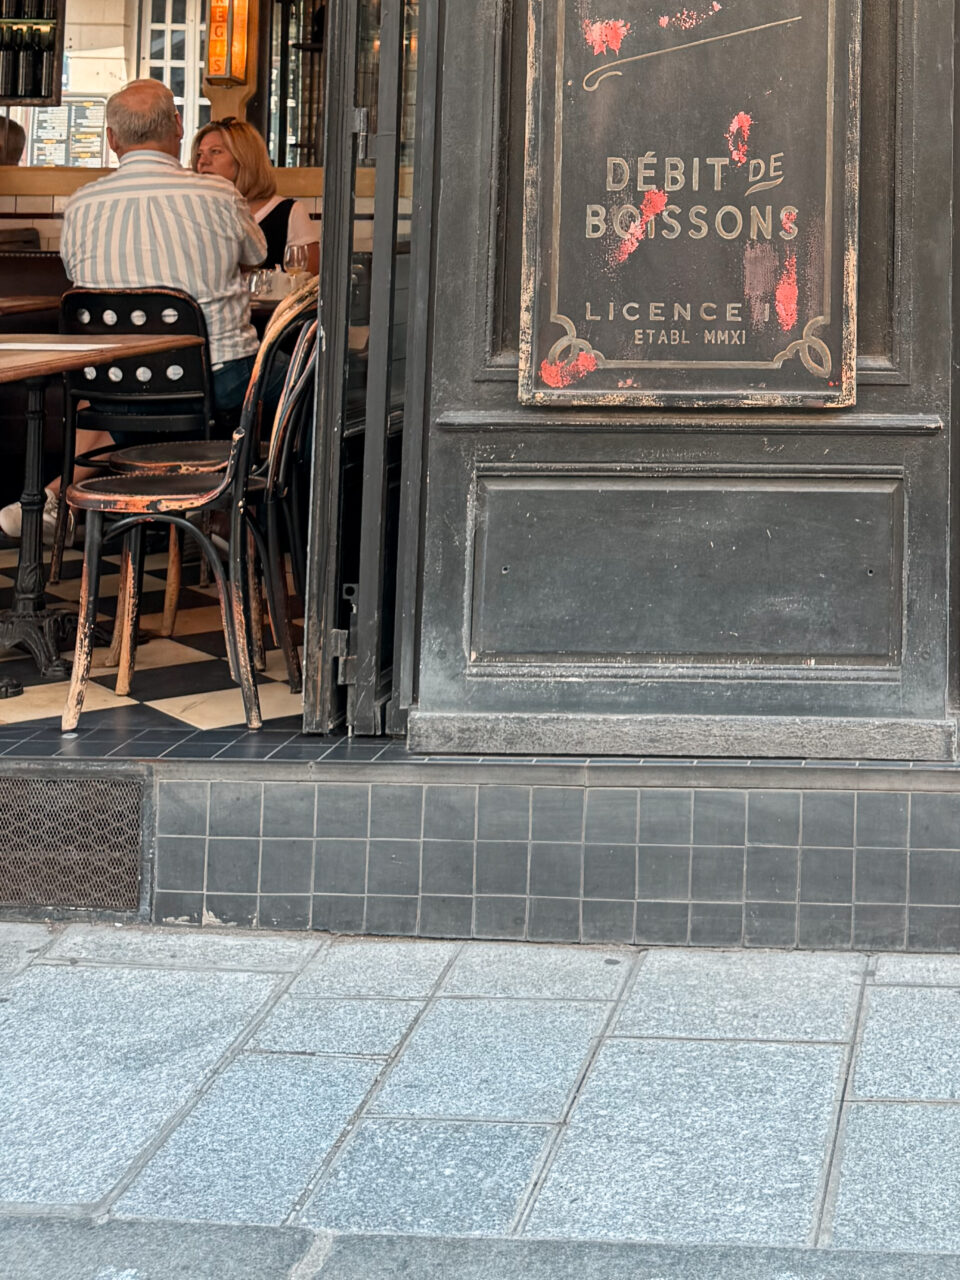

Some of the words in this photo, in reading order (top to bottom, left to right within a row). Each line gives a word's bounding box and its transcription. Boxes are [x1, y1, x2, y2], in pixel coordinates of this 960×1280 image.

[605, 151, 730, 191] DÉBIT
[748, 152, 784, 183] DE
[585, 204, 799, 240] BOISSONS
[585, 302, 742, 321] LICENCE
[634, 330, 690, 345] ETABL
[704, 329, 746, 345] MMXI
